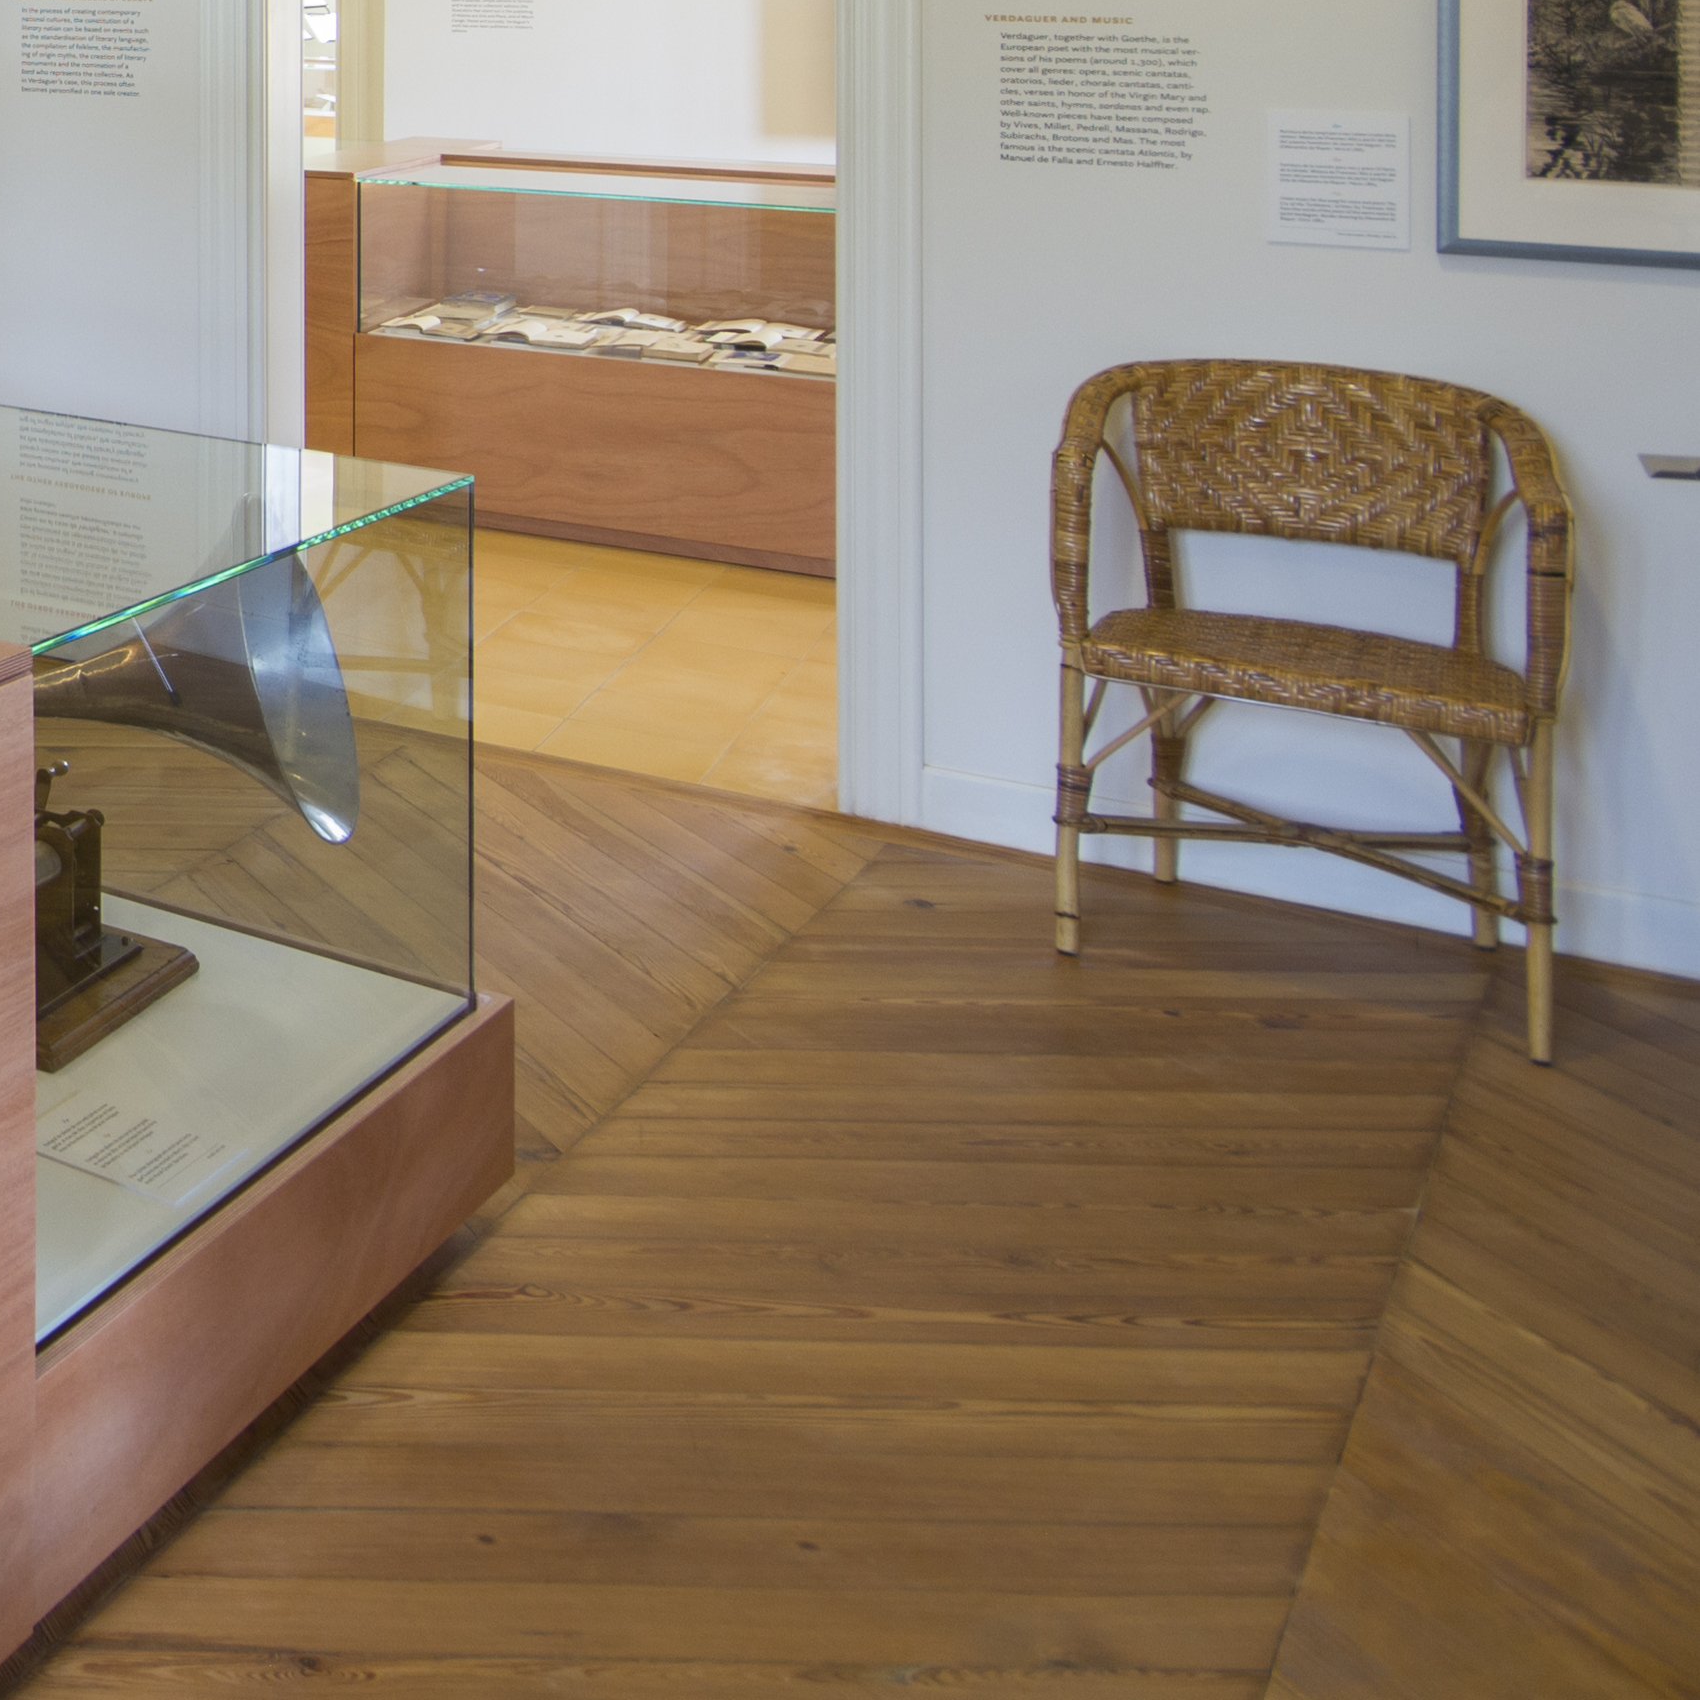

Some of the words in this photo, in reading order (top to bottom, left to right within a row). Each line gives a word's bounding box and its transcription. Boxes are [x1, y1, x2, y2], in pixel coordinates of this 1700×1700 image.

[984, 14, 1058, 23] VERDAGUER
[1091, 16, 1133, 24] MUSIC
[1000, 33, 1051, 42] Verdaguer,
[1053, 34, 1095, 43] together
[1097, 35, 1119, 43] with
[1120, 35, 1159, 44] Goethe,
[1172, 37, 1190, 45] the
